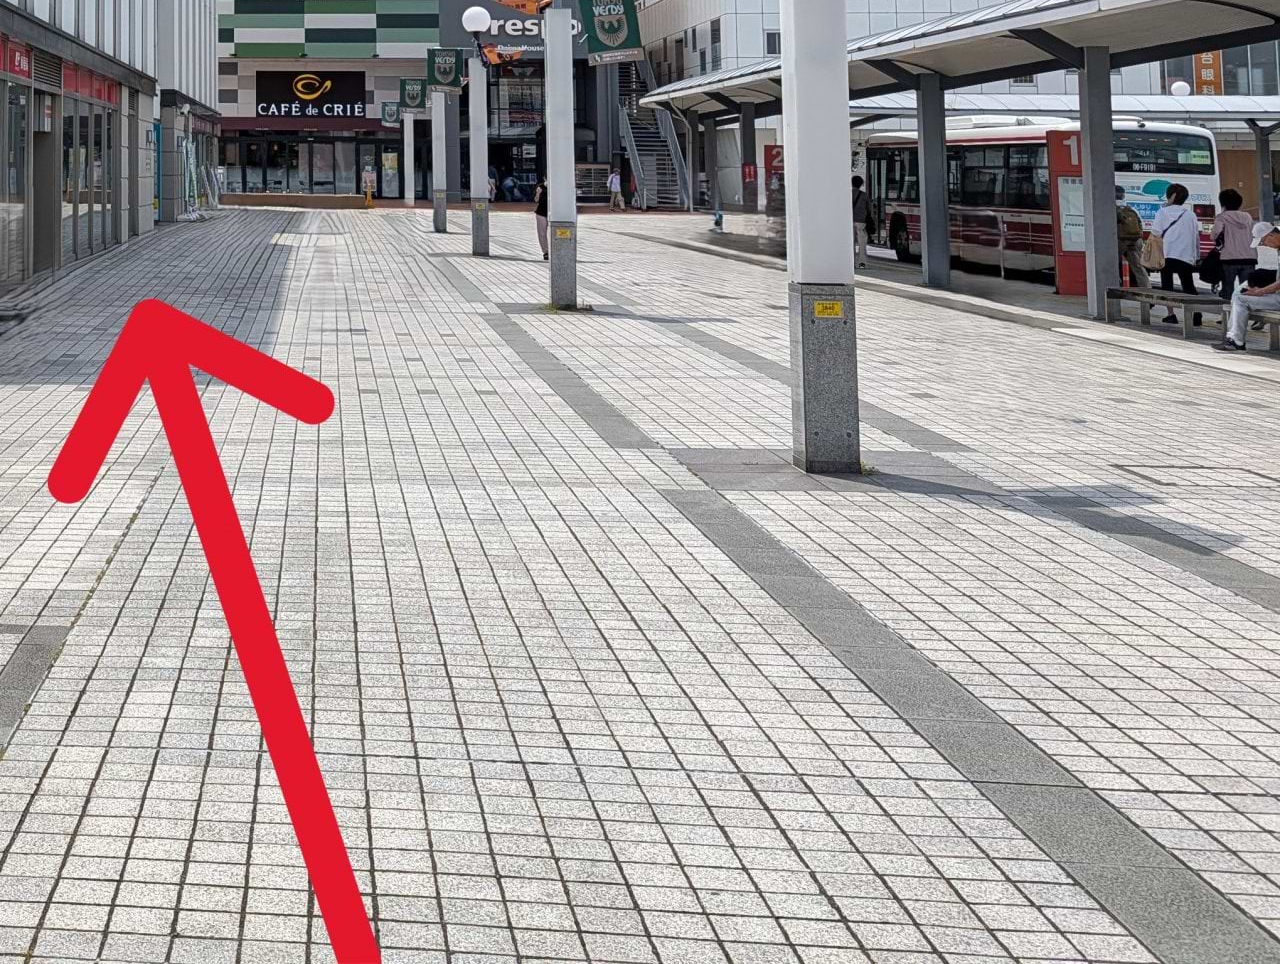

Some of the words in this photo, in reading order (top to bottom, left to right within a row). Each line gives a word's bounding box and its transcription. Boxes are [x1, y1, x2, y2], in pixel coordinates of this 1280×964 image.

[257, 100, 301, 116] CAFÉ
[305, 103, 319, 116] de
[323, 101, 364, 116] CRIÉ
[771, 148, 784, 167] 2
[1062, 135, 1079, 165] 1
